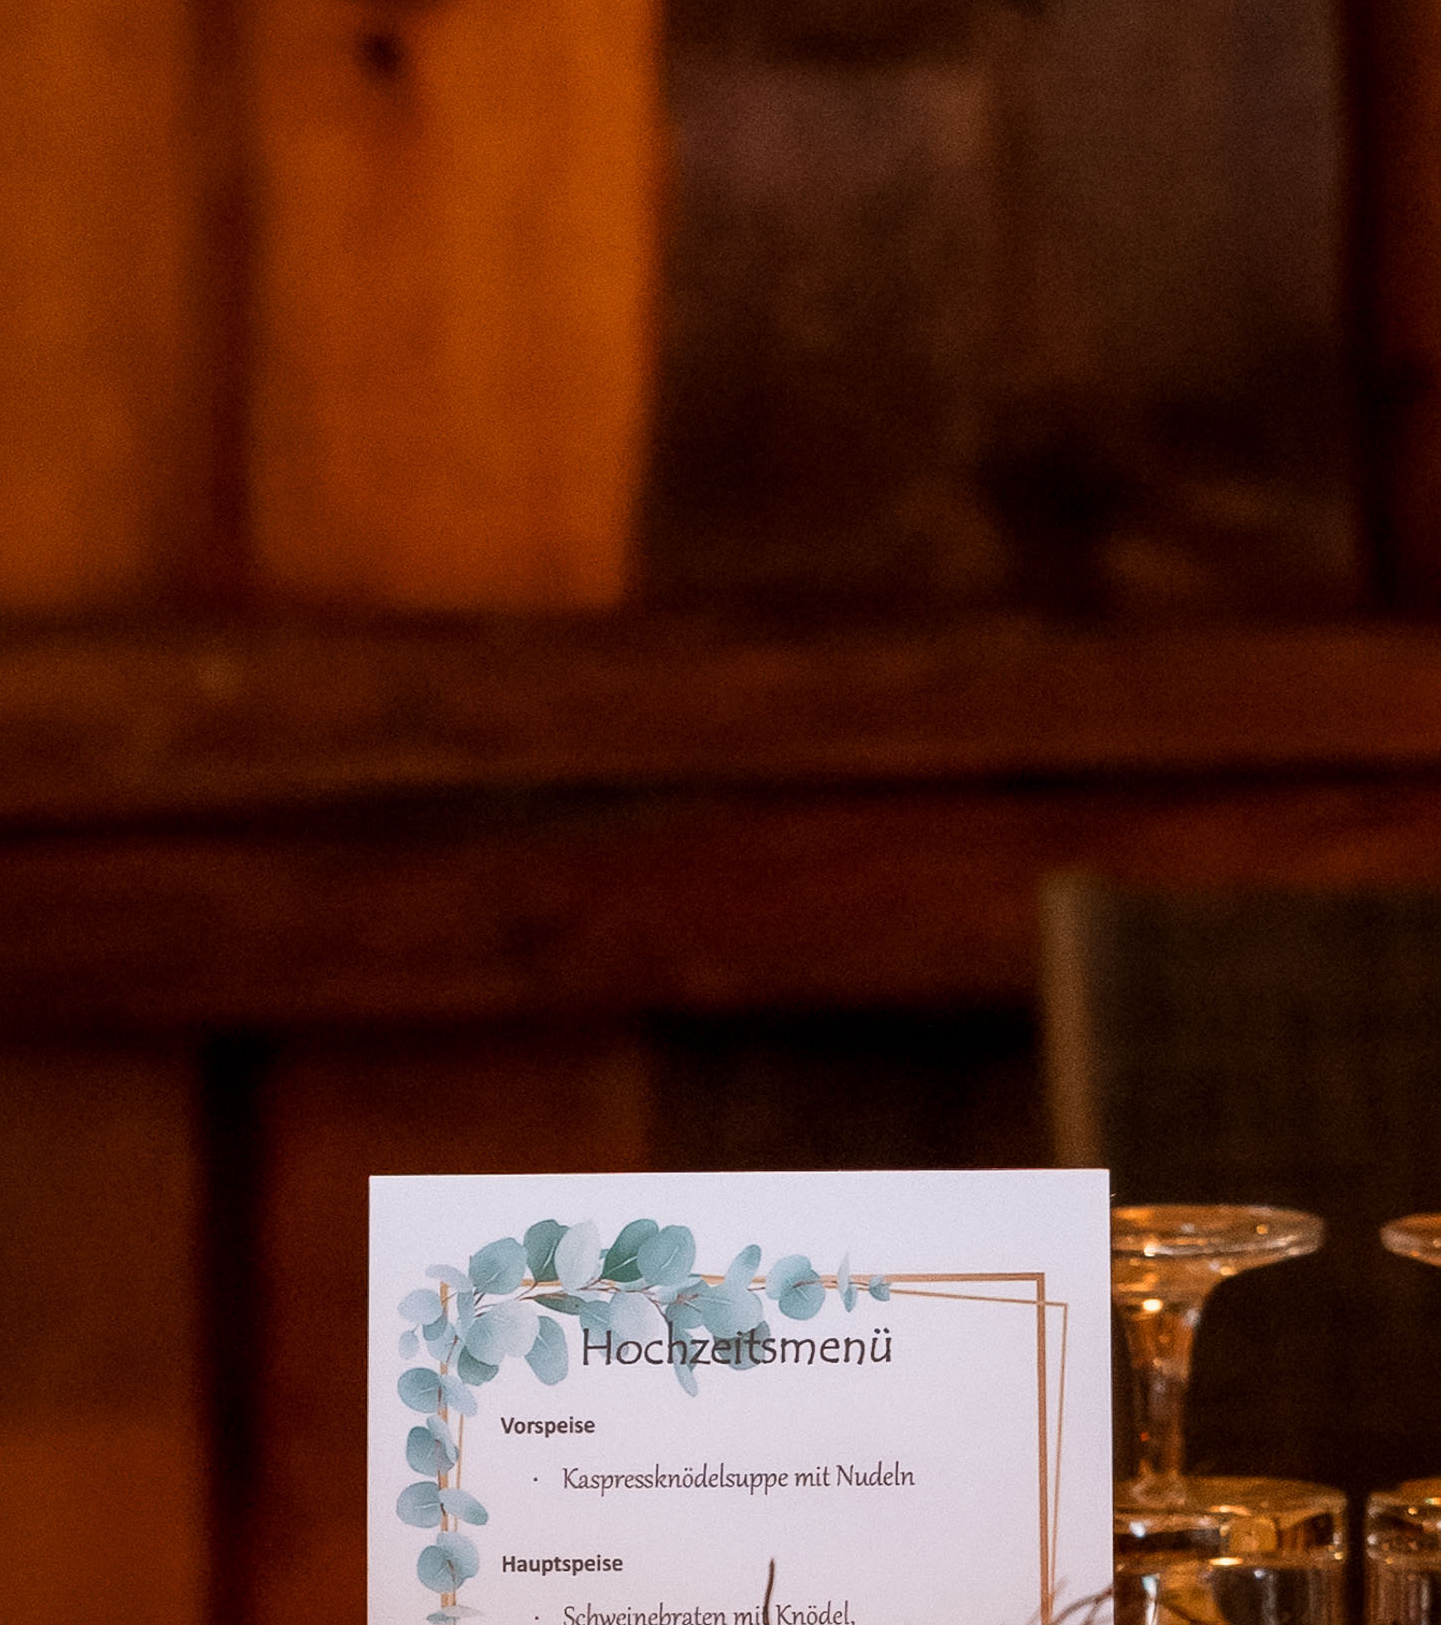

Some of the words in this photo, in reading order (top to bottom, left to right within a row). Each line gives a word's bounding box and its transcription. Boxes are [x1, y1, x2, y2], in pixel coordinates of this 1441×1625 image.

[581, 1320, 893, 1366] Hochzeitsmenü
[500, 1416, 596, 1438] Vorspeise
[562, 1463, 789, 1497] Kaspressknödelsuppe
[794, 1466, 831, 1487] mit
[835, 1461, 916, 1487] Nudeln
[502, 1554, 624, 1576] Hauptspeise
